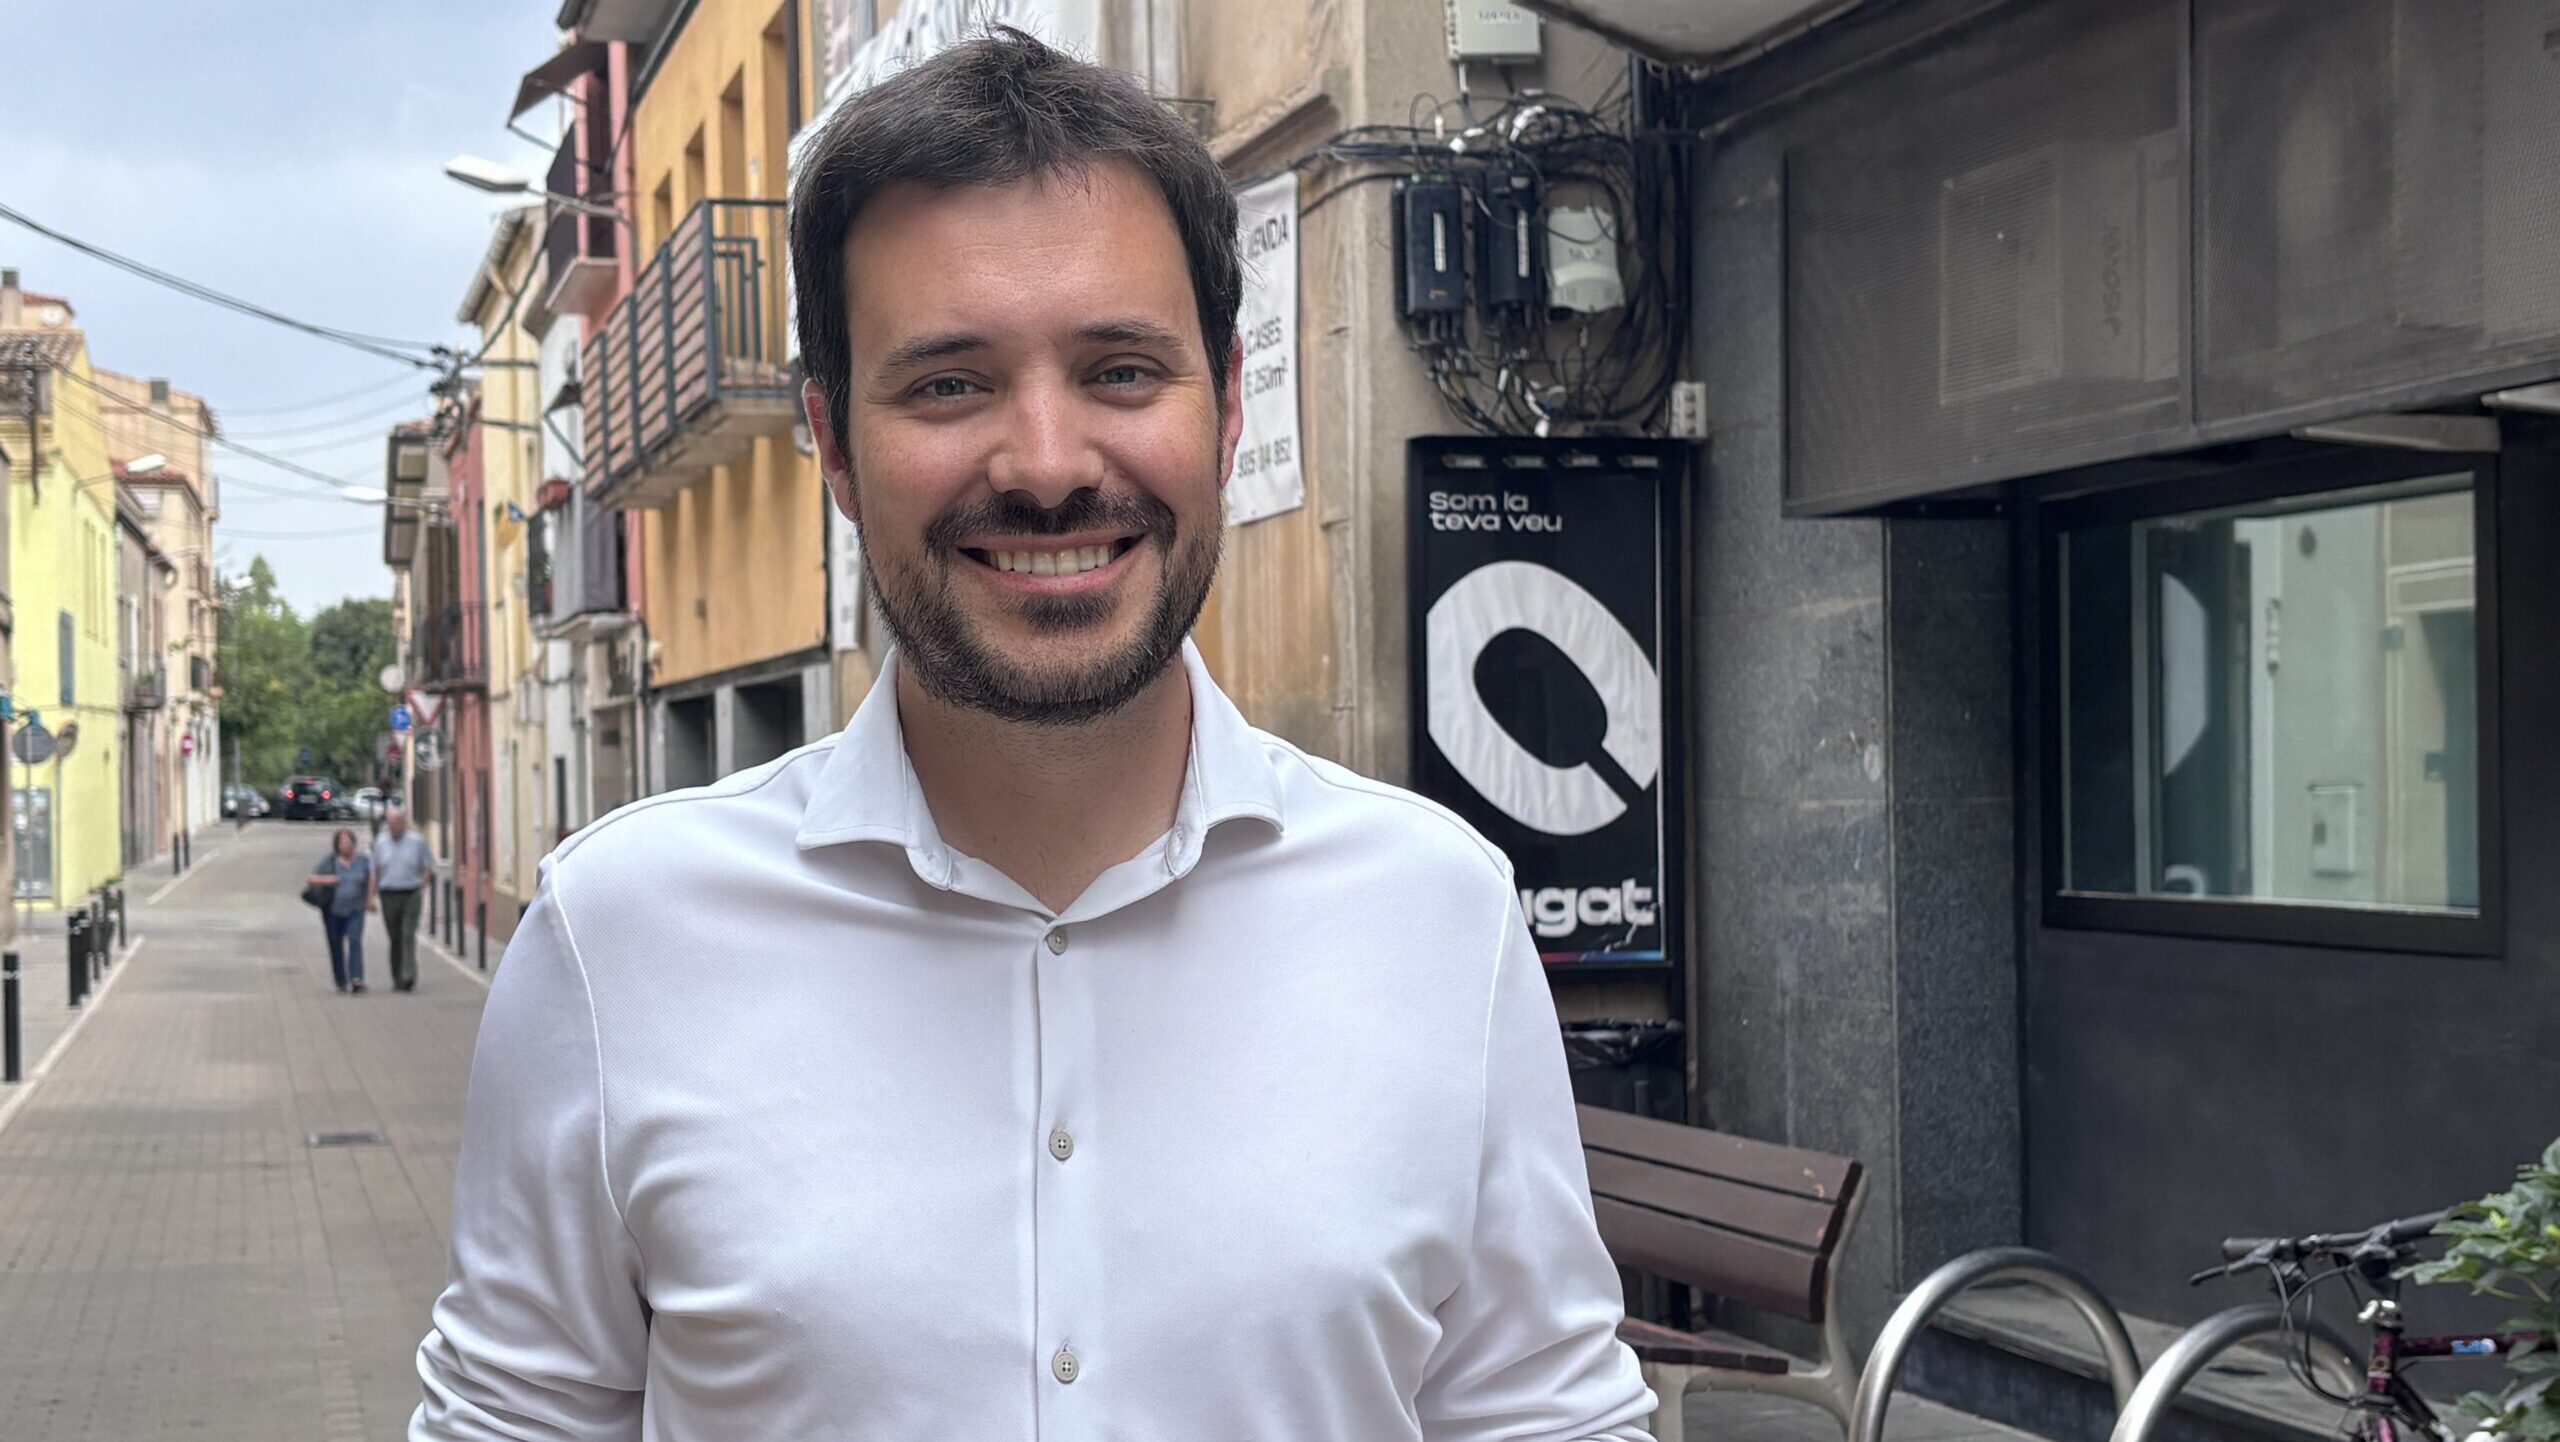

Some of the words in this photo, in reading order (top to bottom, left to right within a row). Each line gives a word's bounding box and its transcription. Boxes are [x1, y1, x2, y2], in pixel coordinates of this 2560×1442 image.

[1429, 491, 1498, 511] Som
[1504, 490, 1529, 511] la
[1429, 511, 1501, 531] teva
[1507, 513, 1563, 532] veu
